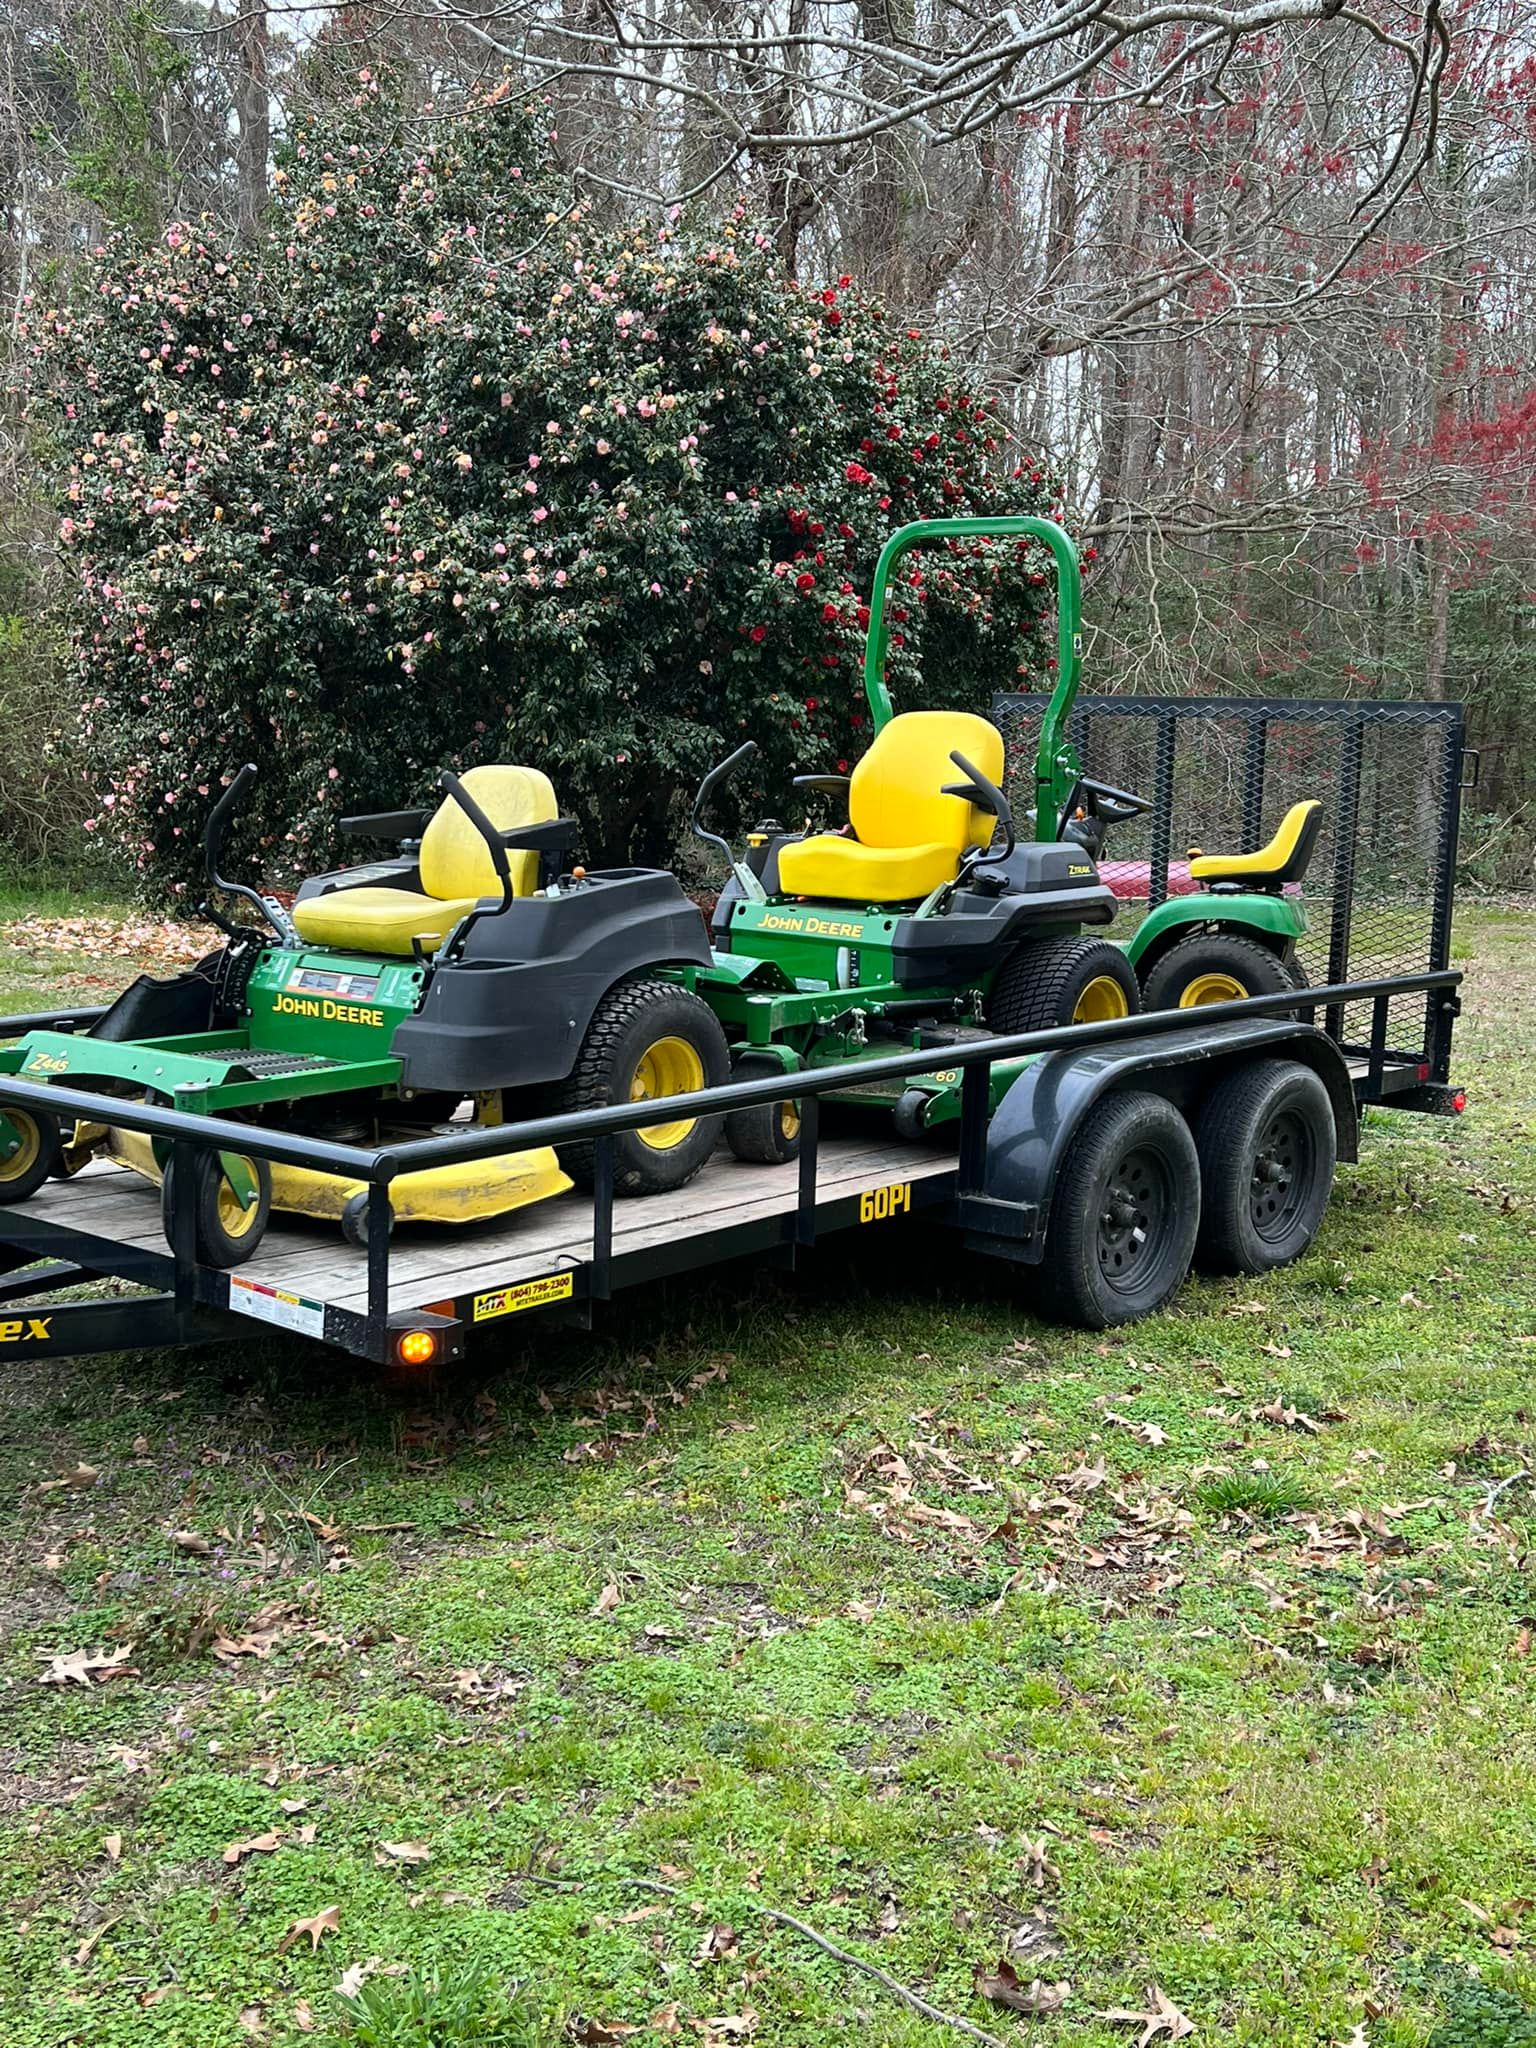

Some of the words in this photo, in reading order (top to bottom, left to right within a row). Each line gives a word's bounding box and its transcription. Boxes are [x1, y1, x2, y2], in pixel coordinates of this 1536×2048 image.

[757, 913, 803, 931] JOHN
[805, 917, 864, 938] DEERE
[272, 993, 320, 1017] JOHN
[322, 999, 384, 1027] DEERE
[936, 1071, 956, 1083] 60
